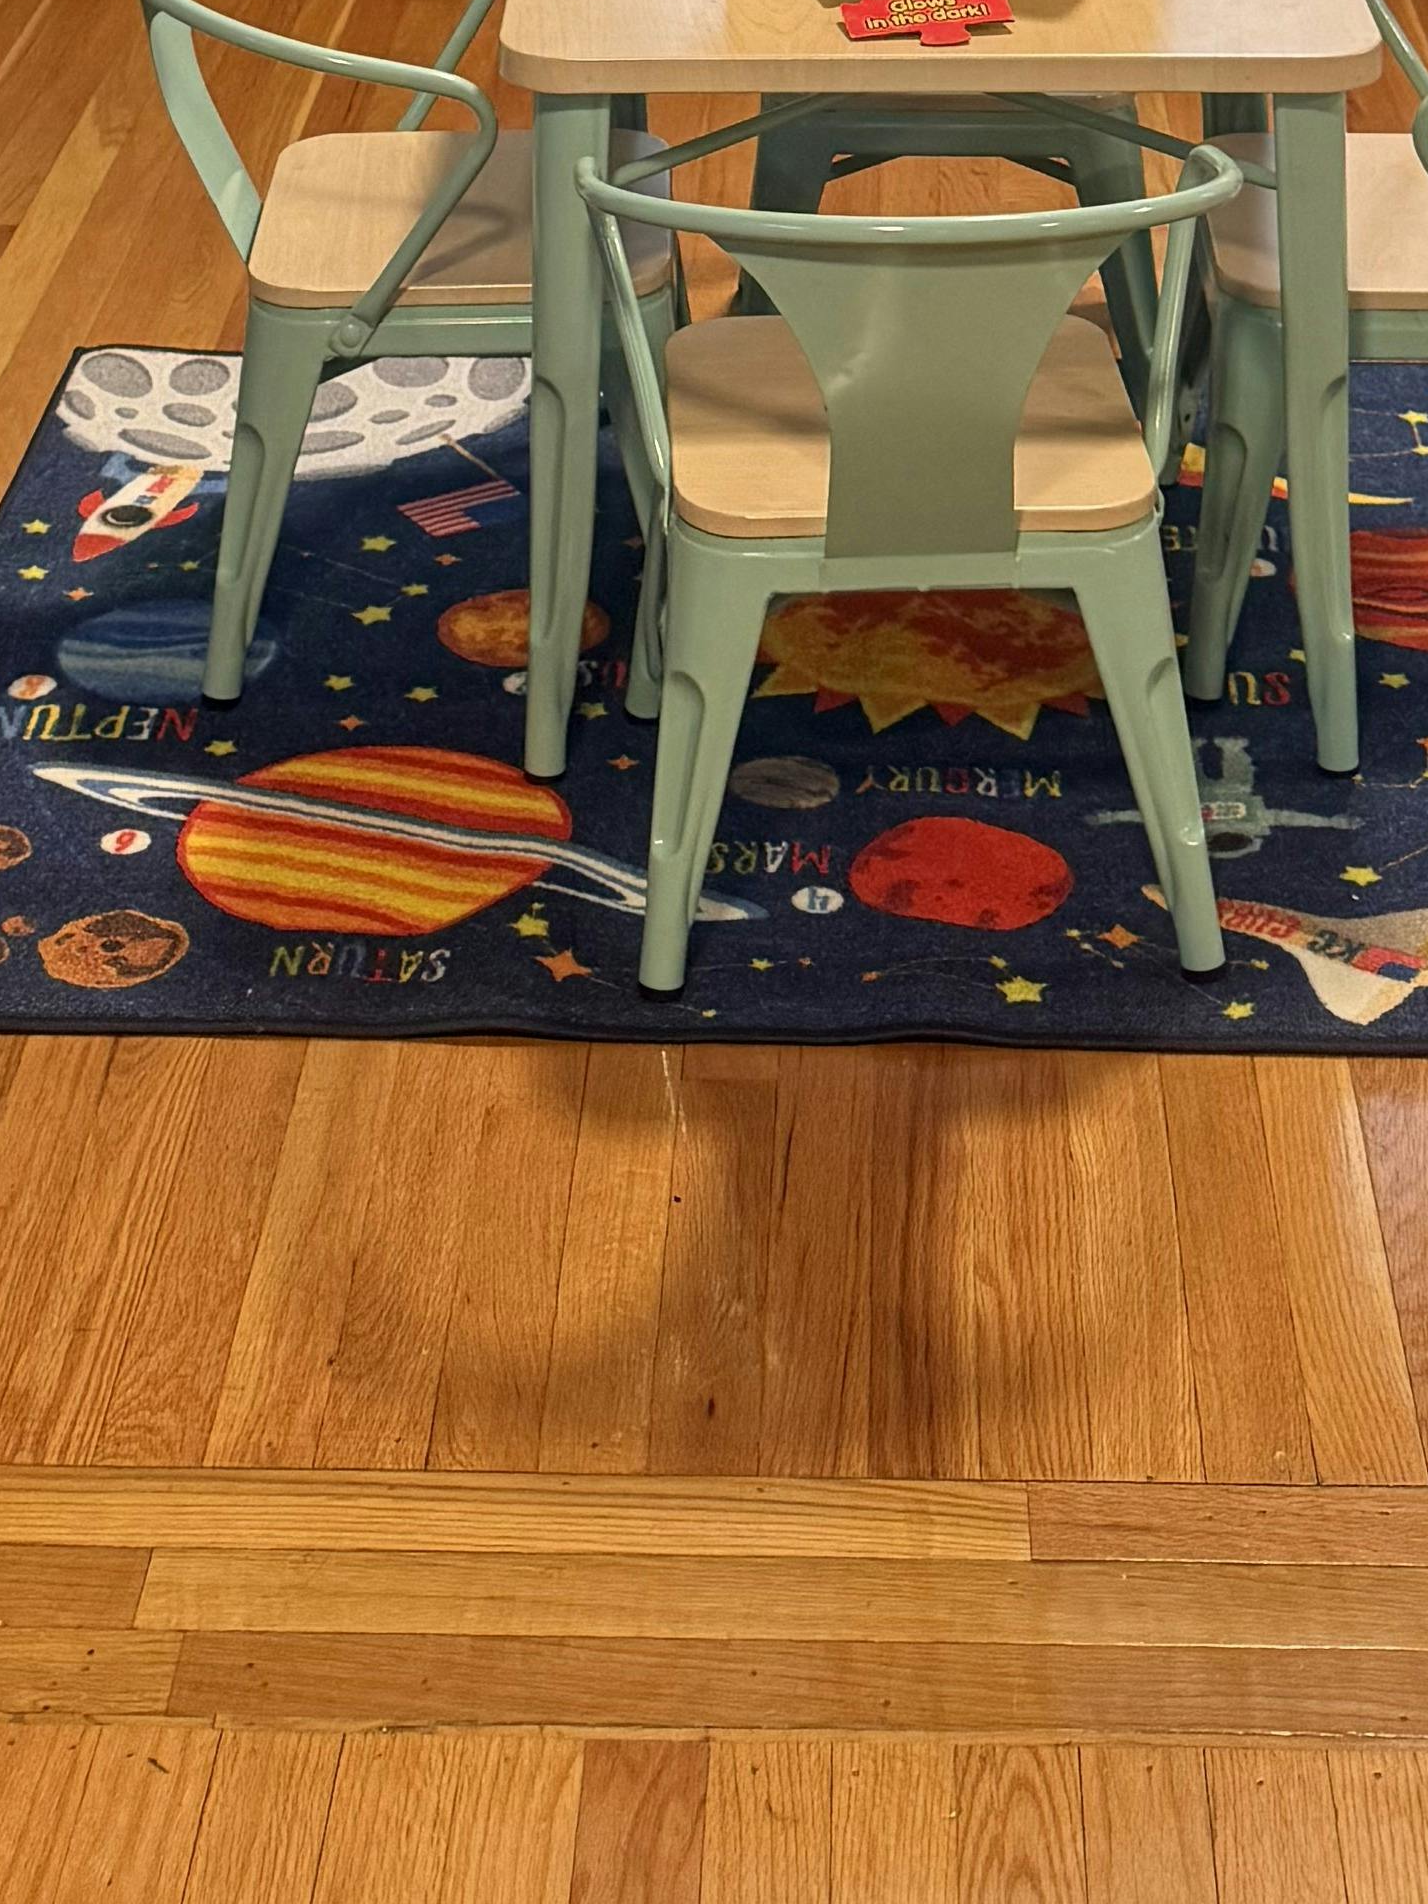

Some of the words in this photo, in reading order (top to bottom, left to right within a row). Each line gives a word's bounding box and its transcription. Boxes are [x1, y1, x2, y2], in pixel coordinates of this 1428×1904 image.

[890, 13, 928, 27] the
[931, 3, 989, 22] dark!
[856, 765, 1062, 798] MERCURY
[706, 841, 831, 877] MARS
[271, 944, 450, 983] SATURN
